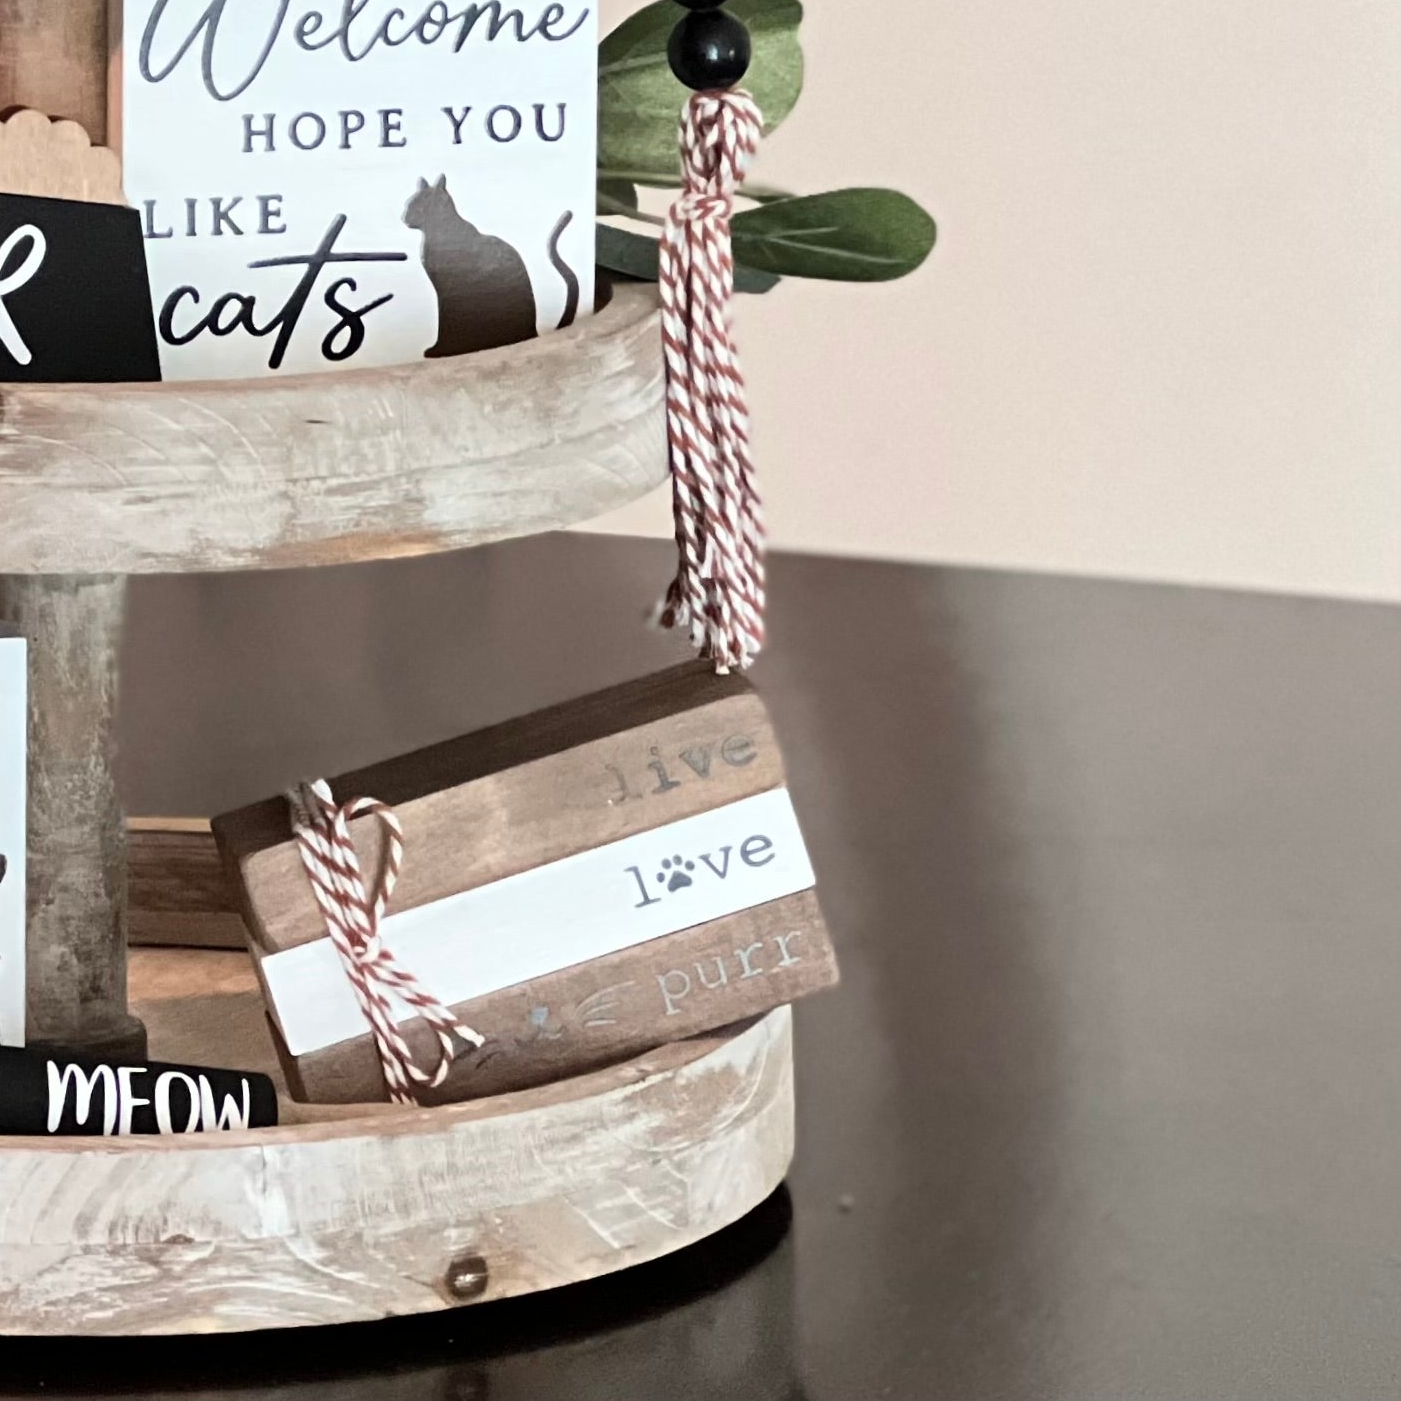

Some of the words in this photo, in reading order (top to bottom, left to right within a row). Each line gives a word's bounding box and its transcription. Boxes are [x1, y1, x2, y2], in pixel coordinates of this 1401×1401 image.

[242, 108, 408, 152] HOPE
[441, 103, 566, 145] YOU
[143, 195, 287, 239] LIKE
[159, 213, 407, 370] cats
[605, 734, 758, 805] live
[656, 931, 802, 1016] purr
[47, 1060, 249, 1136] MEOW
